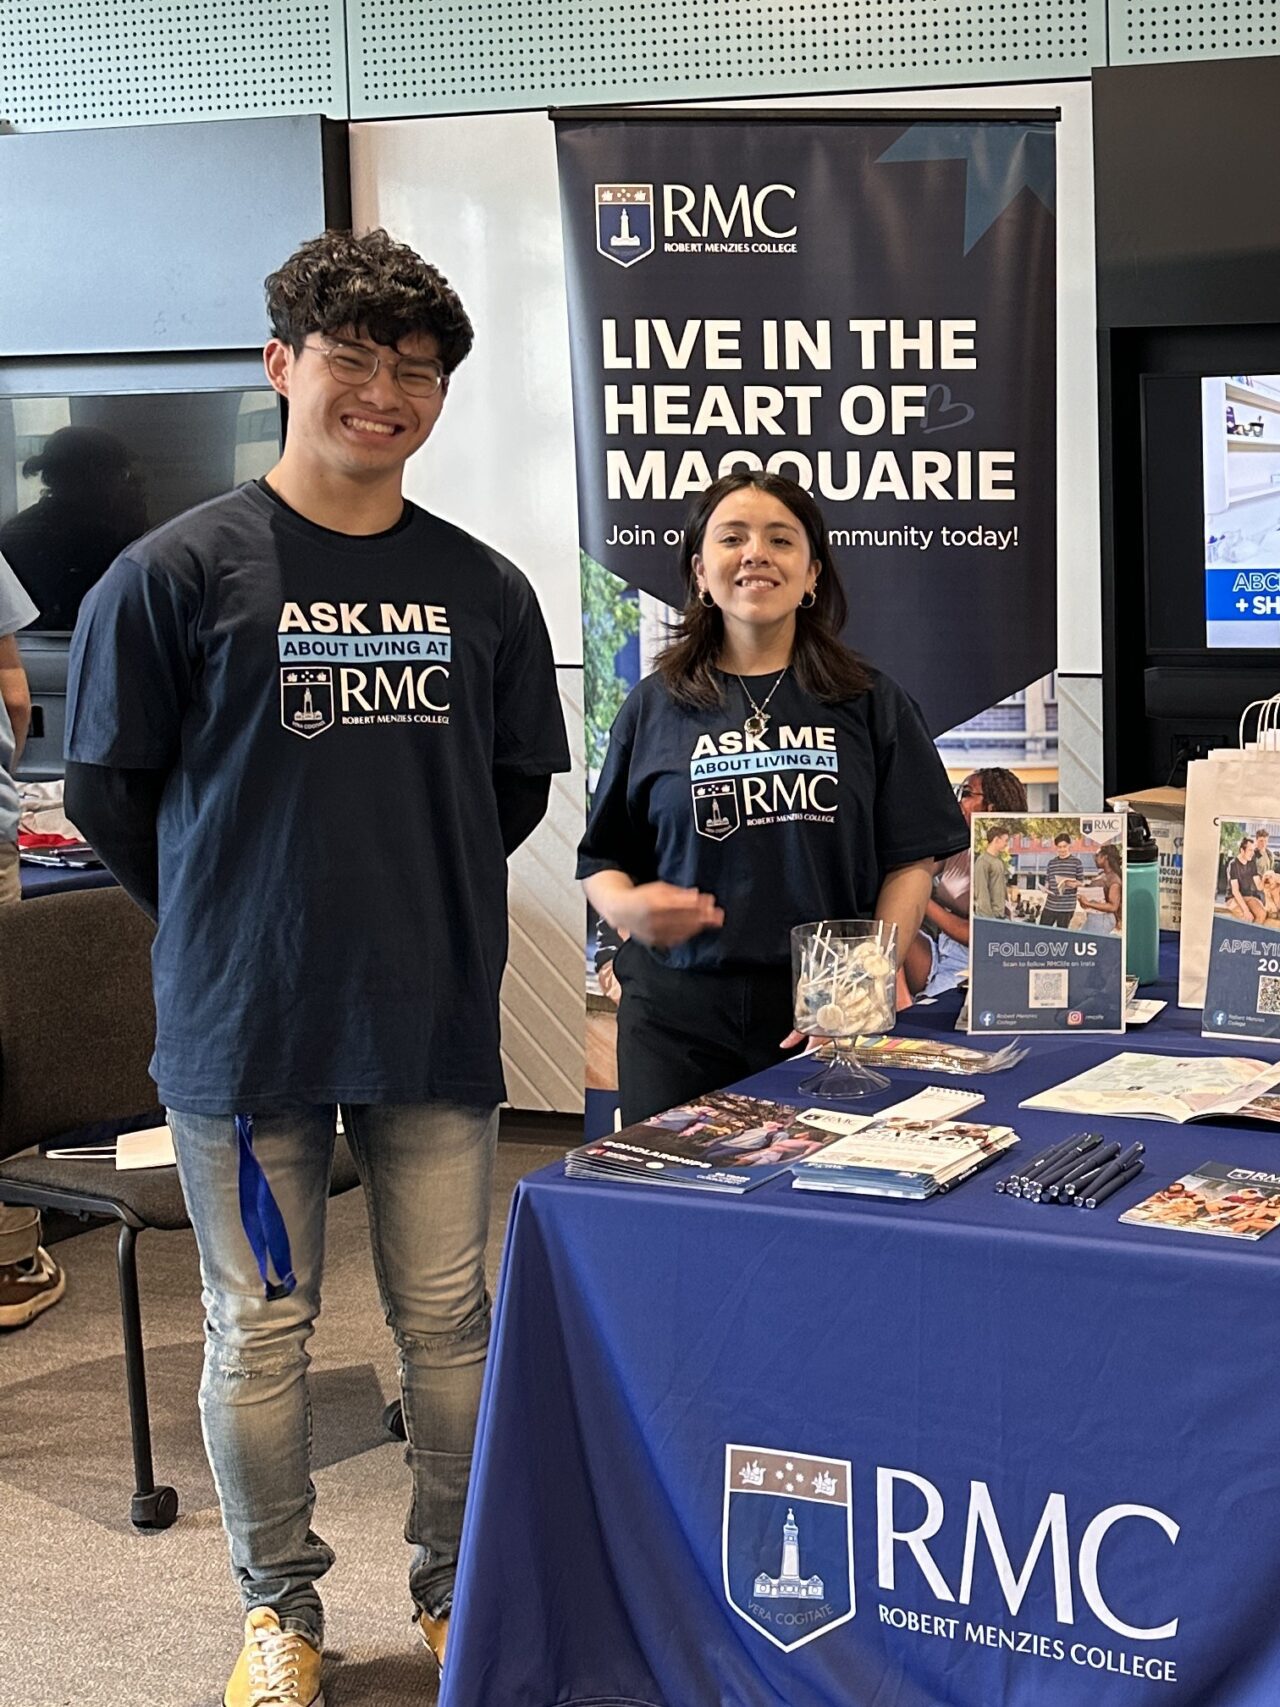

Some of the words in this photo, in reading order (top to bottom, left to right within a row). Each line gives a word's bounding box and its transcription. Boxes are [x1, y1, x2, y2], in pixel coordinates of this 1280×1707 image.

[662, 183, 798, 239] RMC
[664, 242, 702, 253] ROBERT
[704, 242, 750, 253] MENZIES
[751, 242, 798, 254] COLLEGE
[602, 319, 743, 370] LIVE
[763, 319, 831, 370] IN
[849, 319, 977, 370] THE
[604, 384, 823, 436] HEART
[839, 384, 927, 436] OF
[605, 524, 656, 546] Join
[829, 525, 933, 550] mmunity
[941, 525, 1019, 550] today!
[277, 602, 371, 634] ASK
[380, 602, 450, 634] ME
[283, 641, 349, 657] ABOUT
[354, 640, 421, 657] LIVING
[426, 641, 448, 656] AT
[340, 665, 450, 712] RMC
[342, 715, 376, 725] ROBERT
[377, 714, 413, 724] MENZIES
[413, 714, 450, 725] COLLEG
[691, 728, 771, 760] ASK
[778, 725, 837, 751] ME
[694, 758, 752, 776] ABOUT
[756, 754, 811, 769] LIVING
[816, 756, 835, 768] AT
[742, 773, 839, 816] RMC
[747, 816, 775, 826] ROBERT
[803, 813, 835, 824] COLLEGE
[1094, 819, 1119, 830] RMC
[988, 942, 1069, 957] FOLLOW
[1074, 942, 1098, 956] US
[876, 1466, 1181, 1640] RMC
[747, 1600, 772, 1622] VERA
[775, 1603, 834, 1626] COGITATE
[878, 1603, 959, 1639] ROBERT
[964, 1622, 1065, 1661] MENZIES
[1070, 1643, 1177, 1682] COLLEGE
